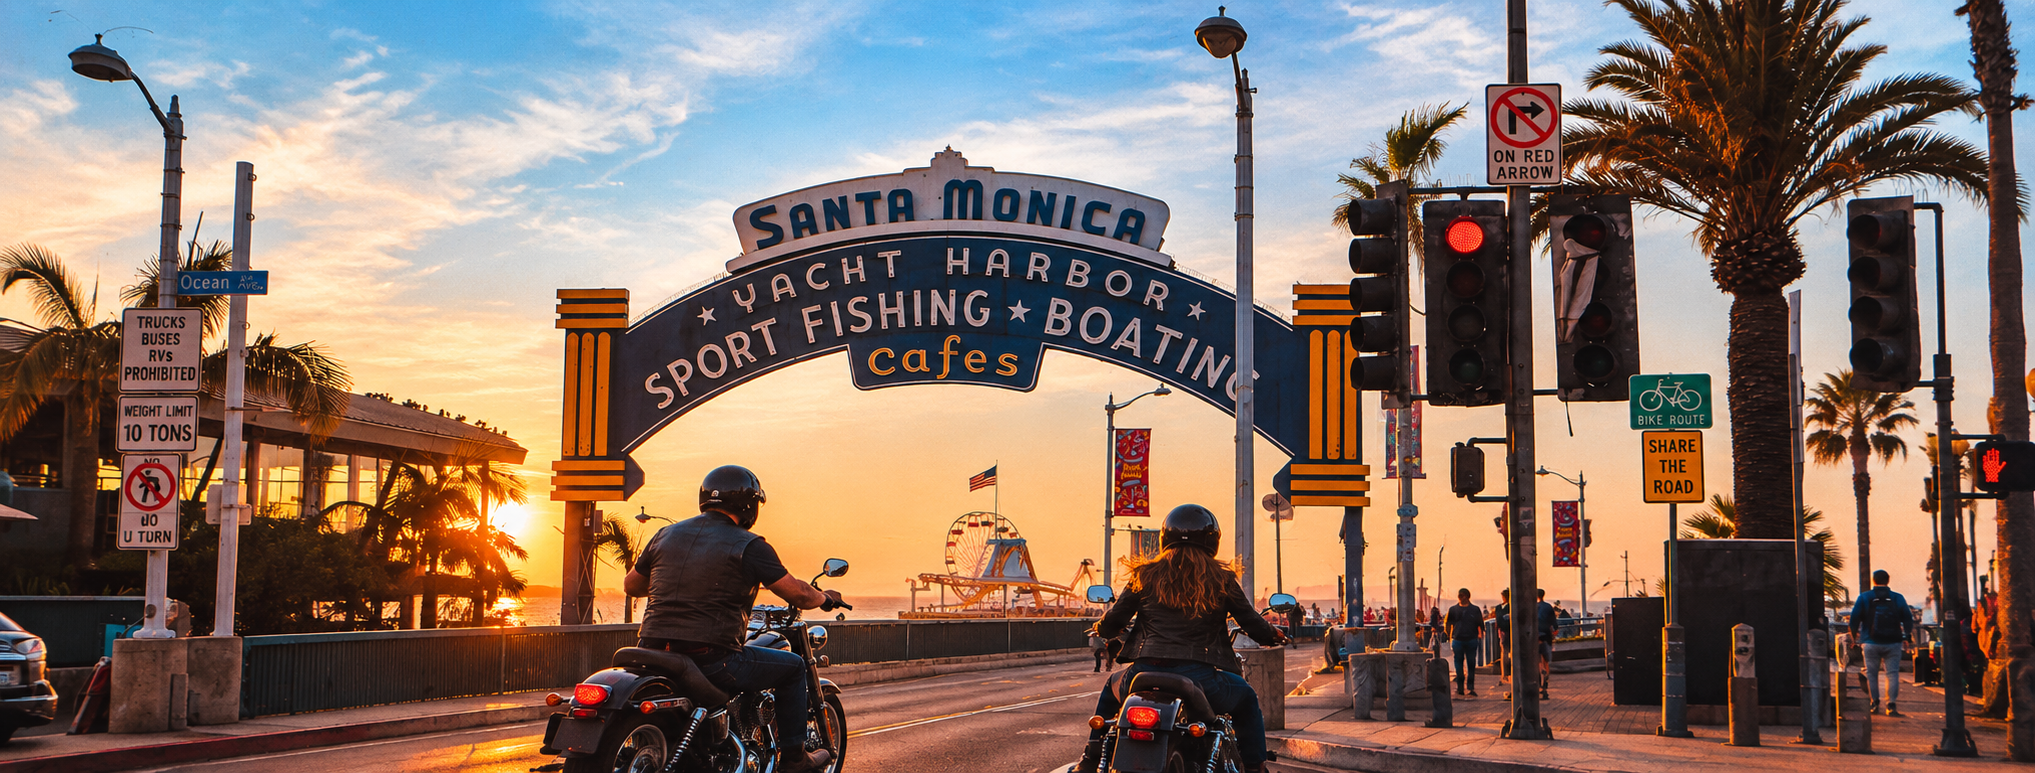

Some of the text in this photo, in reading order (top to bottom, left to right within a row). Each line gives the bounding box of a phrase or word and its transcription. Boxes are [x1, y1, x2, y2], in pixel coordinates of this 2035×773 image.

[1493, 149, 1554, 163] ON RED
[1496, 166, 1554, 179] ARROW
[749, 178, 1146, 250] SANTA MONICA
[180, 274, 229, 290] Ocean
[732, 247, 1170, 314] YACHT HARBOR
[136, 315, 187, 329] TRUCKS
[141, 332, 181, 346] BUSES
[148, 349, 174, 362] RVs
[644, 317, 777, 410] SPORT
[801, 289, 991, 344] FISHING
[867, 334, 1019, 380] cafes
[124, 366, 196, 381] PROHIBITED
[124, 405, 193, 417] WEIGHT LIMIT
[1637, 414, 1705, 426] BIKE ROUTE
[123, 424, 192, 442] 10 TONS
[1648, 438, 1697, 453] SHARE
[1658, 459, 1687, 474] THE
[1653, 479, 1694, 494] ROAD
[123, 530, 172, 543] U TURN
